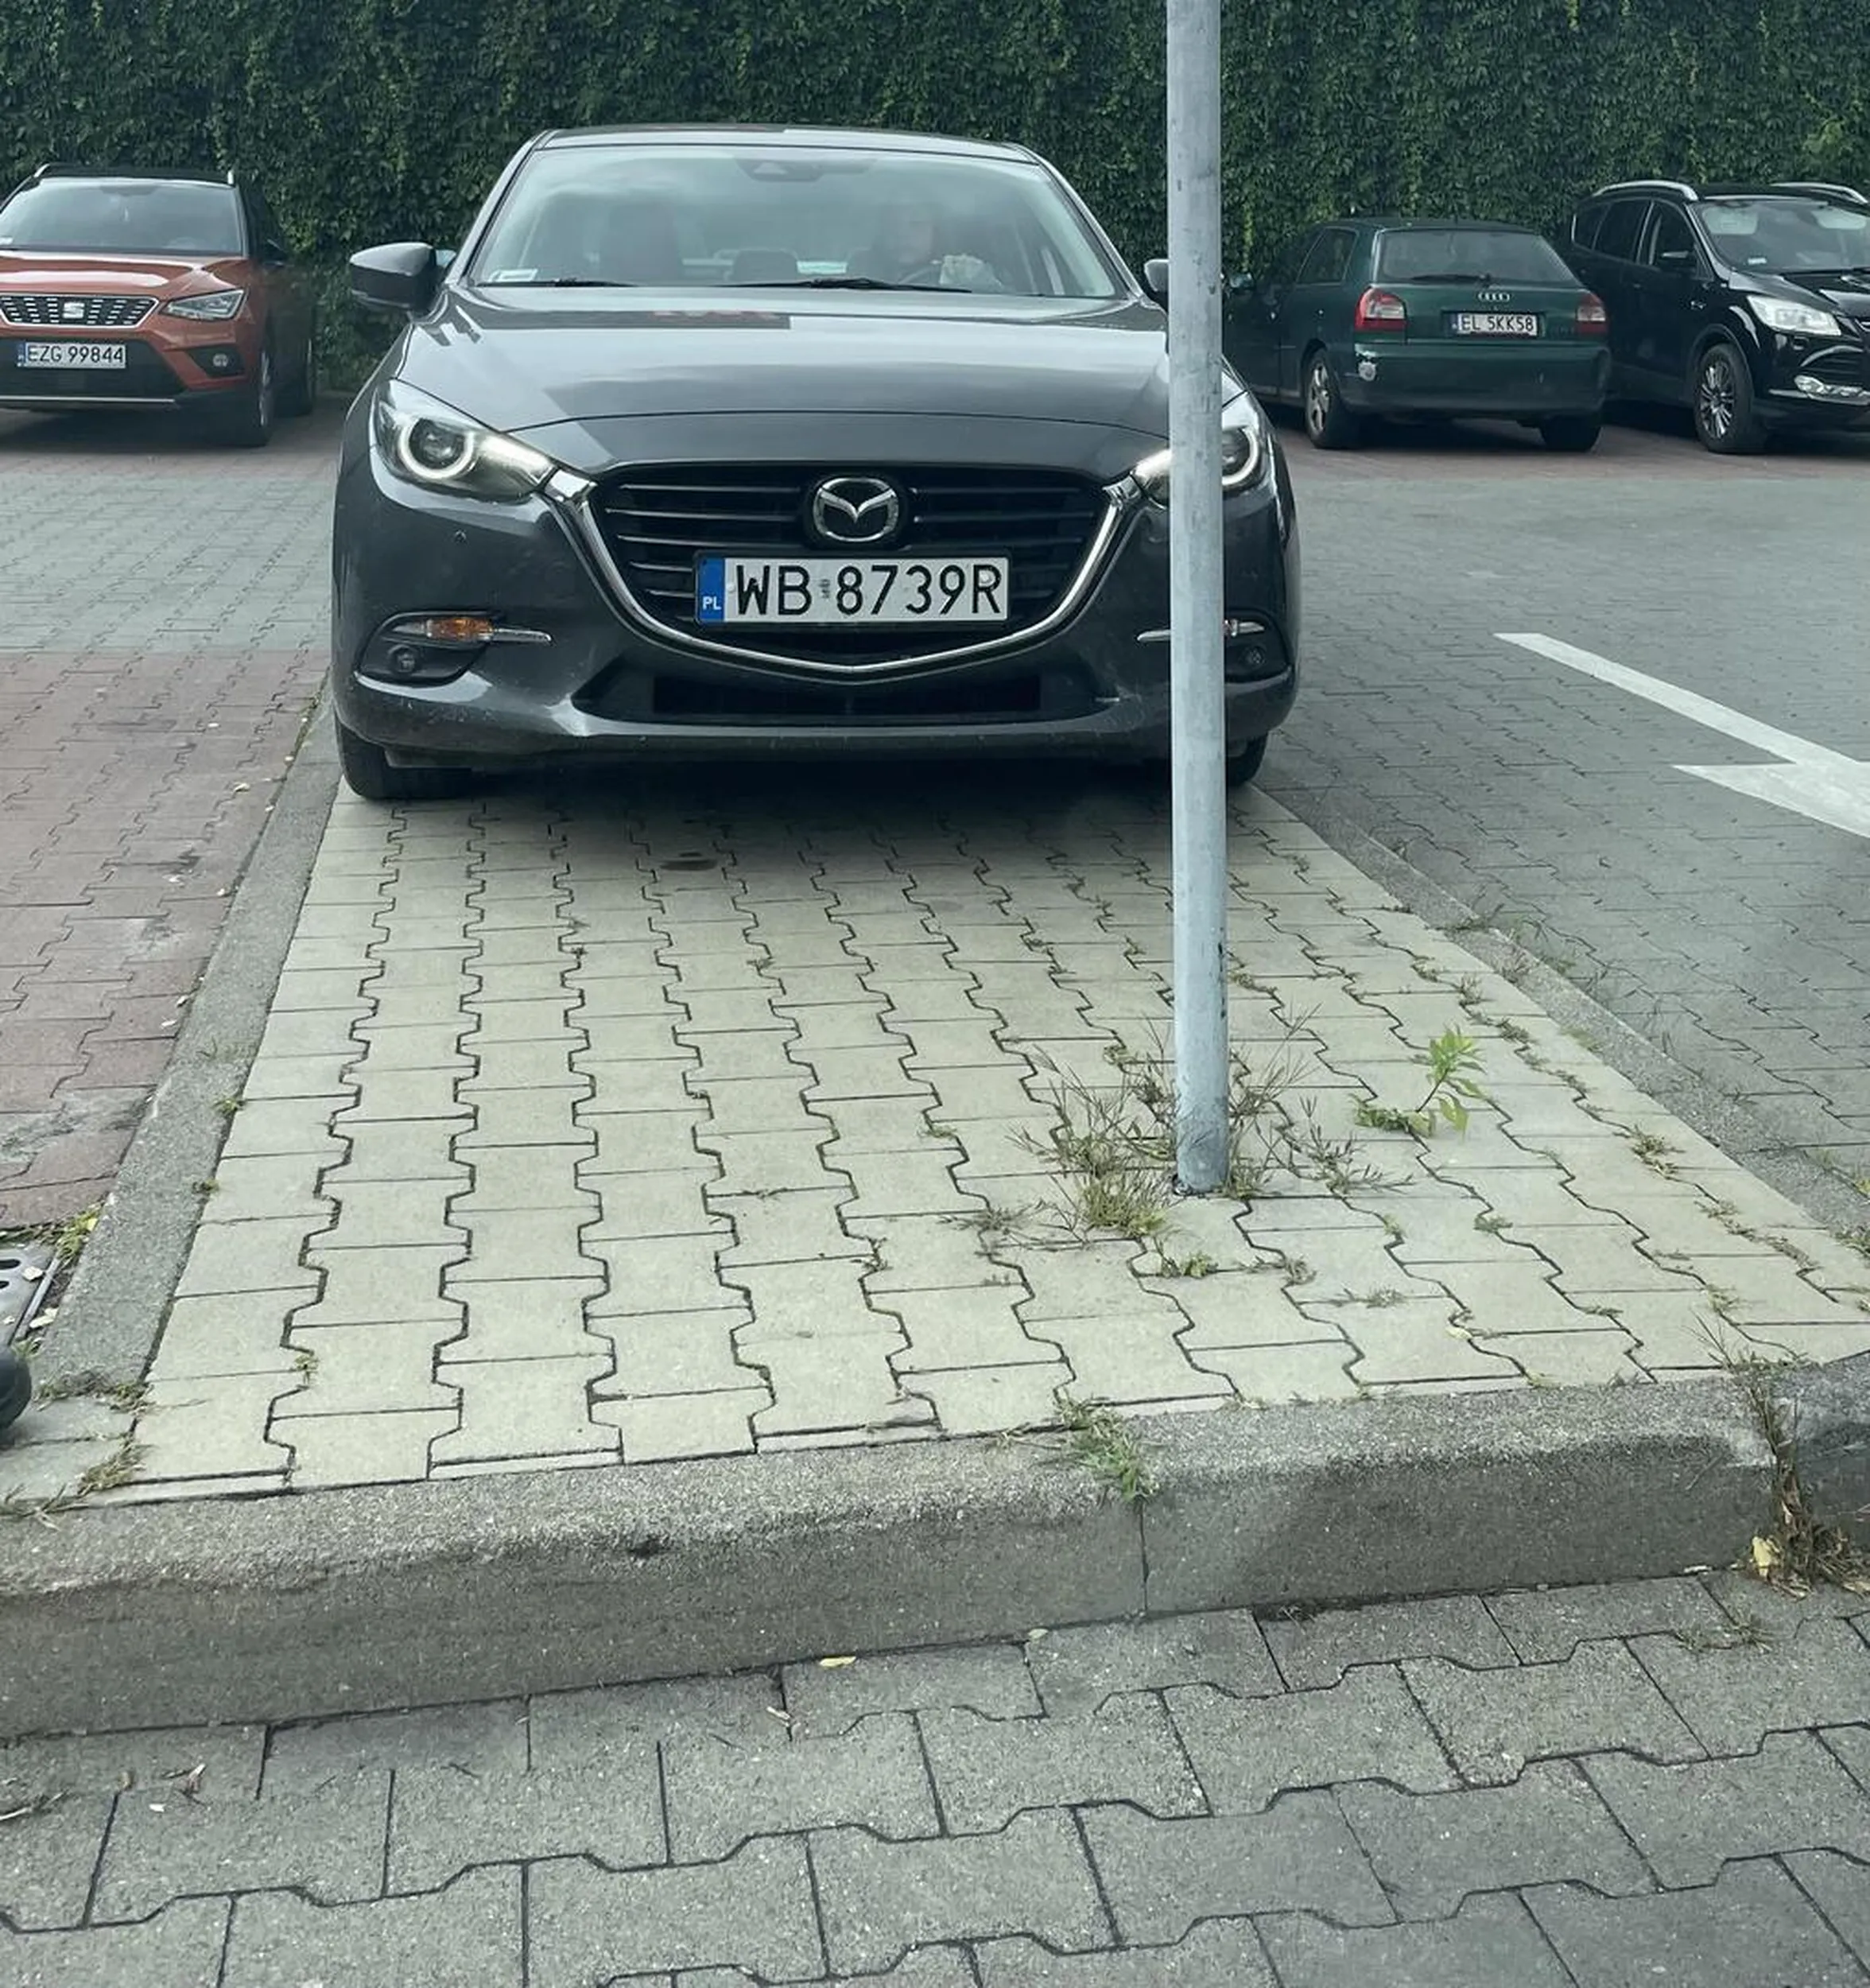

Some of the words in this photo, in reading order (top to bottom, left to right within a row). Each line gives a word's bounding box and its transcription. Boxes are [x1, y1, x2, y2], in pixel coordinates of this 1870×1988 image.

[1461, 315, 1480, 331] EL
[28, 345, 62, 362] EZG
[68, 345, 124, 363] 99844
[735, 564, 813, 615] WB
[836, 564, 1003, 615] 8739R
[702, 597, 722, 611] PL
